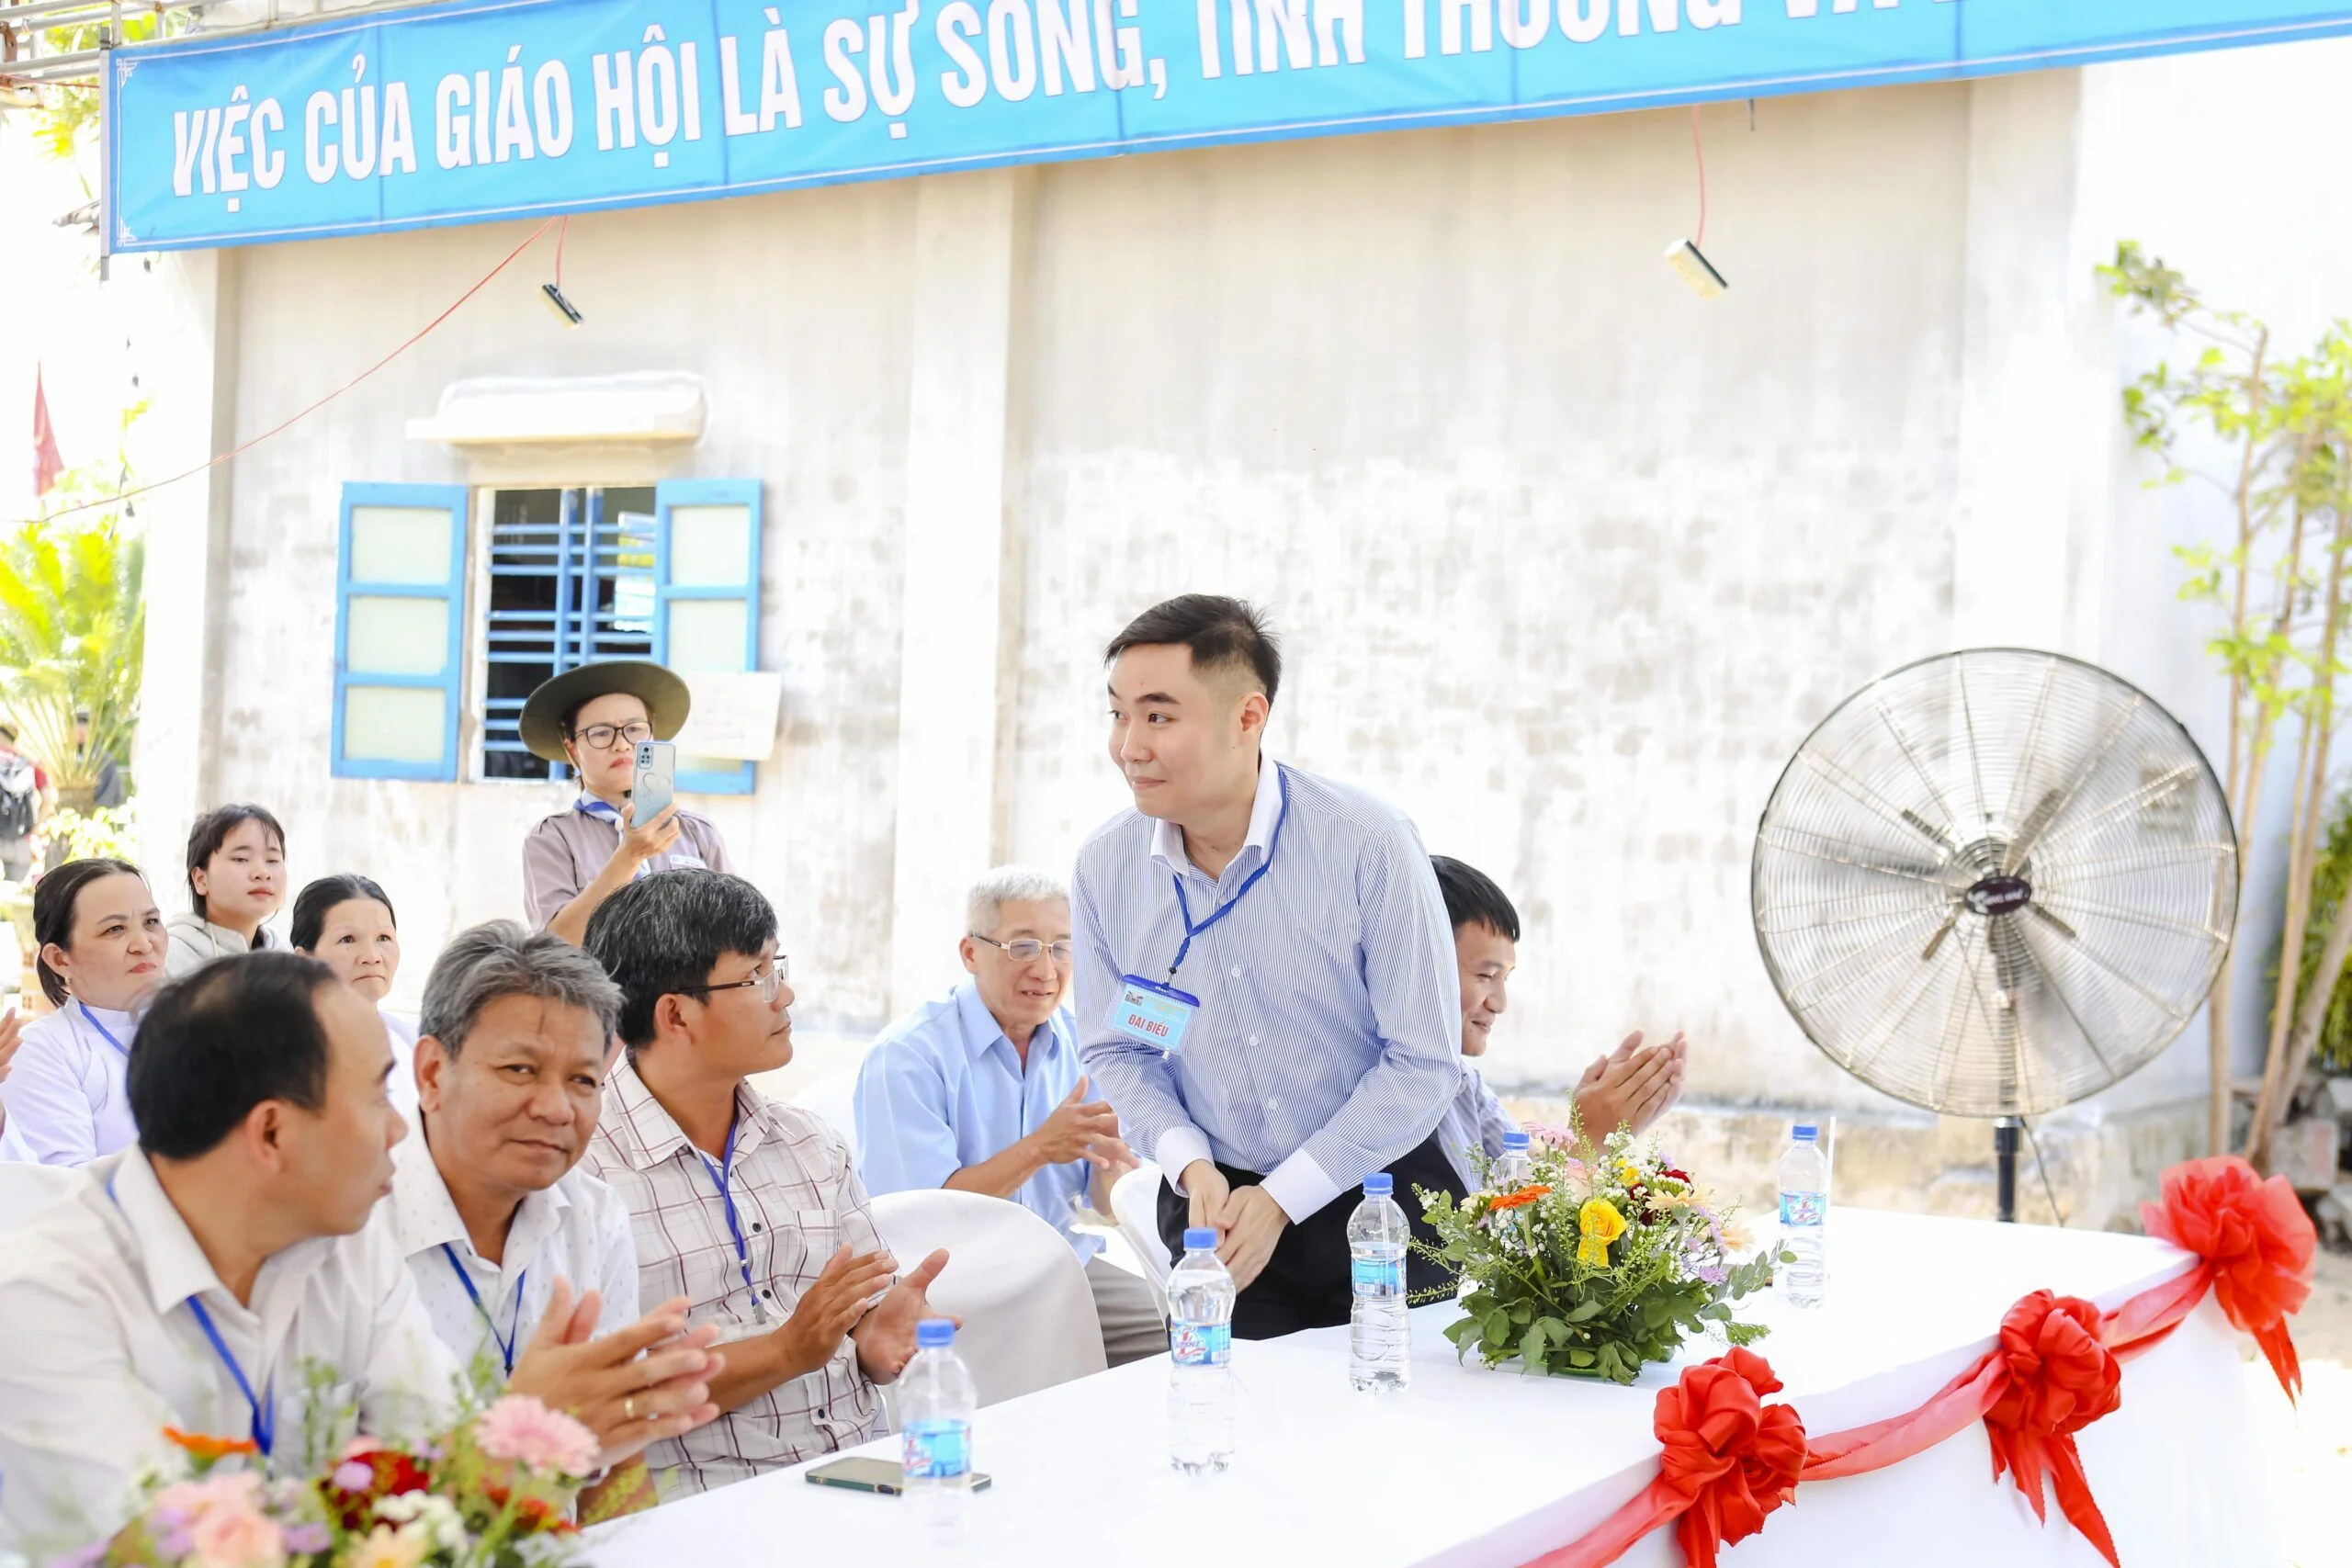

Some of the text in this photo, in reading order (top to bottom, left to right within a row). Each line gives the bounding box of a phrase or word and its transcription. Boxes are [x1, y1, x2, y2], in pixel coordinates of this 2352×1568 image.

[173, 85, 286, 213] VIỆC
[304, 53, 417, 184] CỦA
[435, 44, 574, 171] GIÁO
[592, 23, 702, 169] HỘI
[719, 7, 803, 138] LÀ
[823, 0, 920, 140] SỰ
